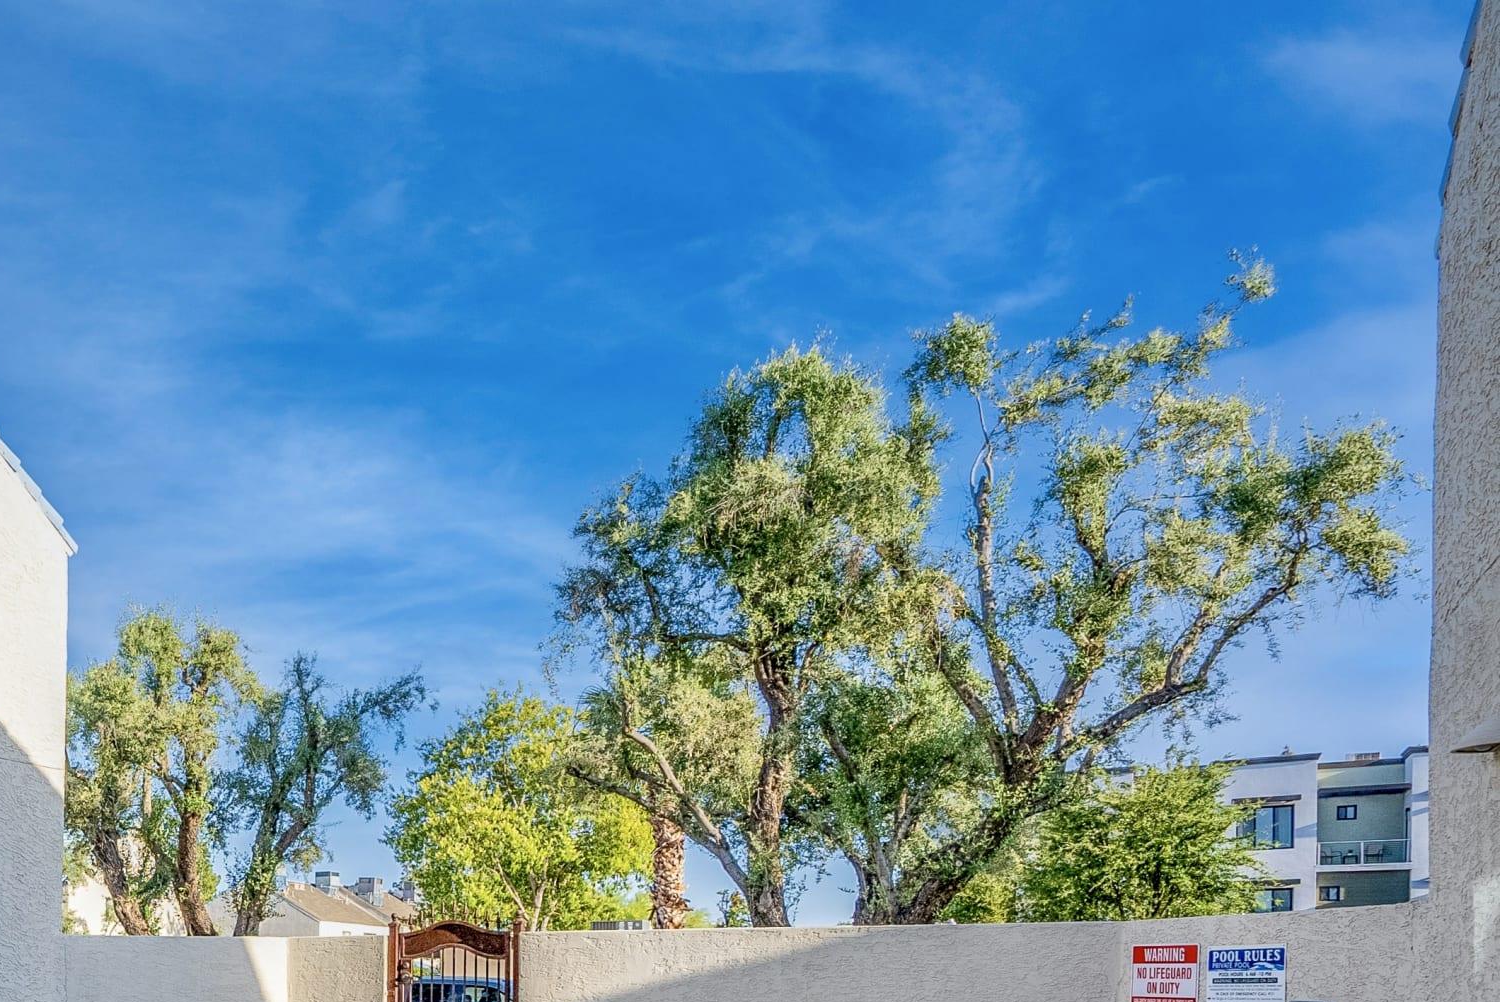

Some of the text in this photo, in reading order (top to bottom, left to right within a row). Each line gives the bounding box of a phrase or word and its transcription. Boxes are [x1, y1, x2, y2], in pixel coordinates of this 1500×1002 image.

[1144, 947, 1185, 962] WARNING
[1212, 949, 1281, 963] POOL RULES
[1137, 967, 1192, 980] NO LIFEGUARD
[1147, 981, 1180, 995] ON DUTY
